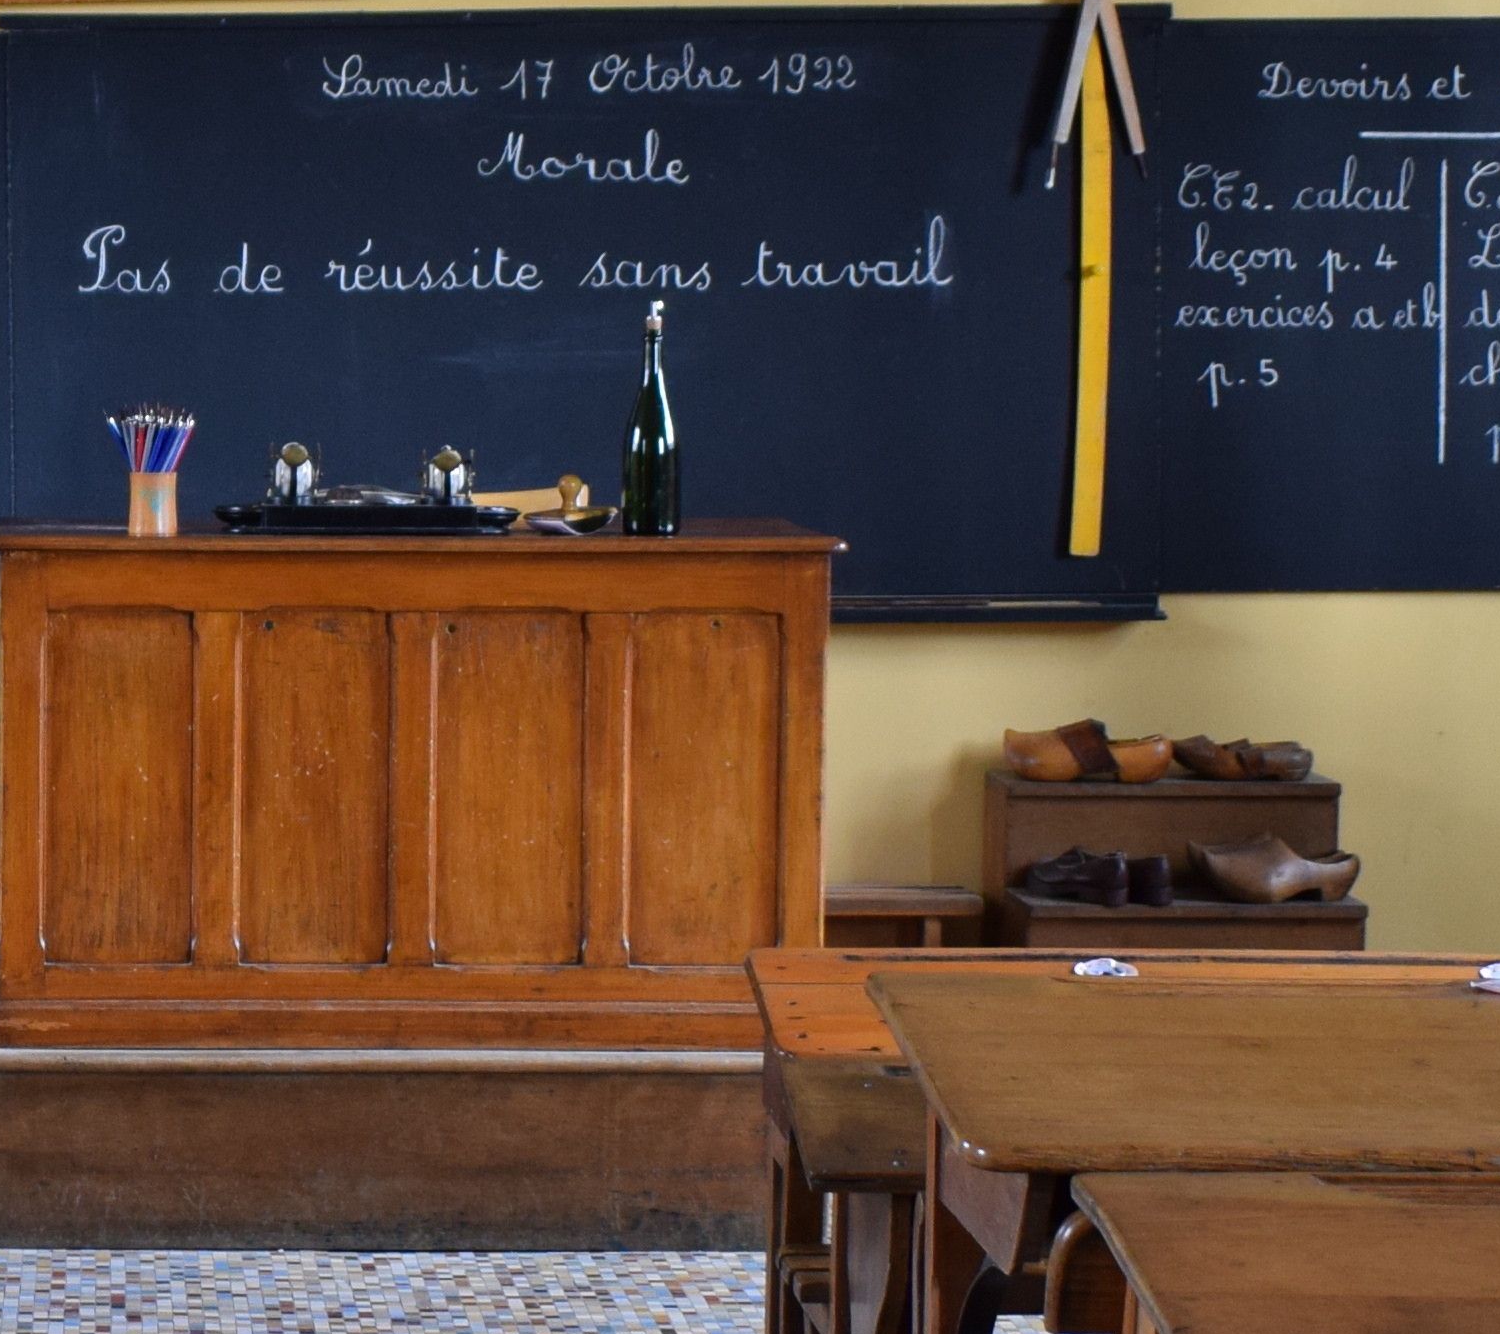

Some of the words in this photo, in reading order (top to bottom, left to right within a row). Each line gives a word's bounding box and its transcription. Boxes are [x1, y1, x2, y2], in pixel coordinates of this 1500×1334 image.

[320, 52, 480, 100] Samedi
[498, 58, 555, 101] 17
[587, 41, 743, 96] Octobre
[756, 53, 858, 96] 1922
[1256, 61, 1413, 101] Devoirs
[1426, 64, 1472, 100] et
[476, 128, 690, 185] Morale
[1291, 153, 1415, 213] calcul
[76, 223, 172, 295] Pas
[214, 242, 285, 294] de
[323, 237, 545, 294] réussite
[577, 251, 713, 293] sans
[739, 213, 955, 290] travail
[1187, 220, 1298, 287] leçon
[1317, 248, 1361, 294] p.
[1373, 242, 1399, 271] 4
[1173, 293, 1335, 331] exercices
[1351, 304, 1386, 331] a
[1391, 297, 1418, 330] et
[1421, 281, 1441, 329] b
[1196, 360, 1247, 409] p.
[1257, 357, 1280, 388] 5
